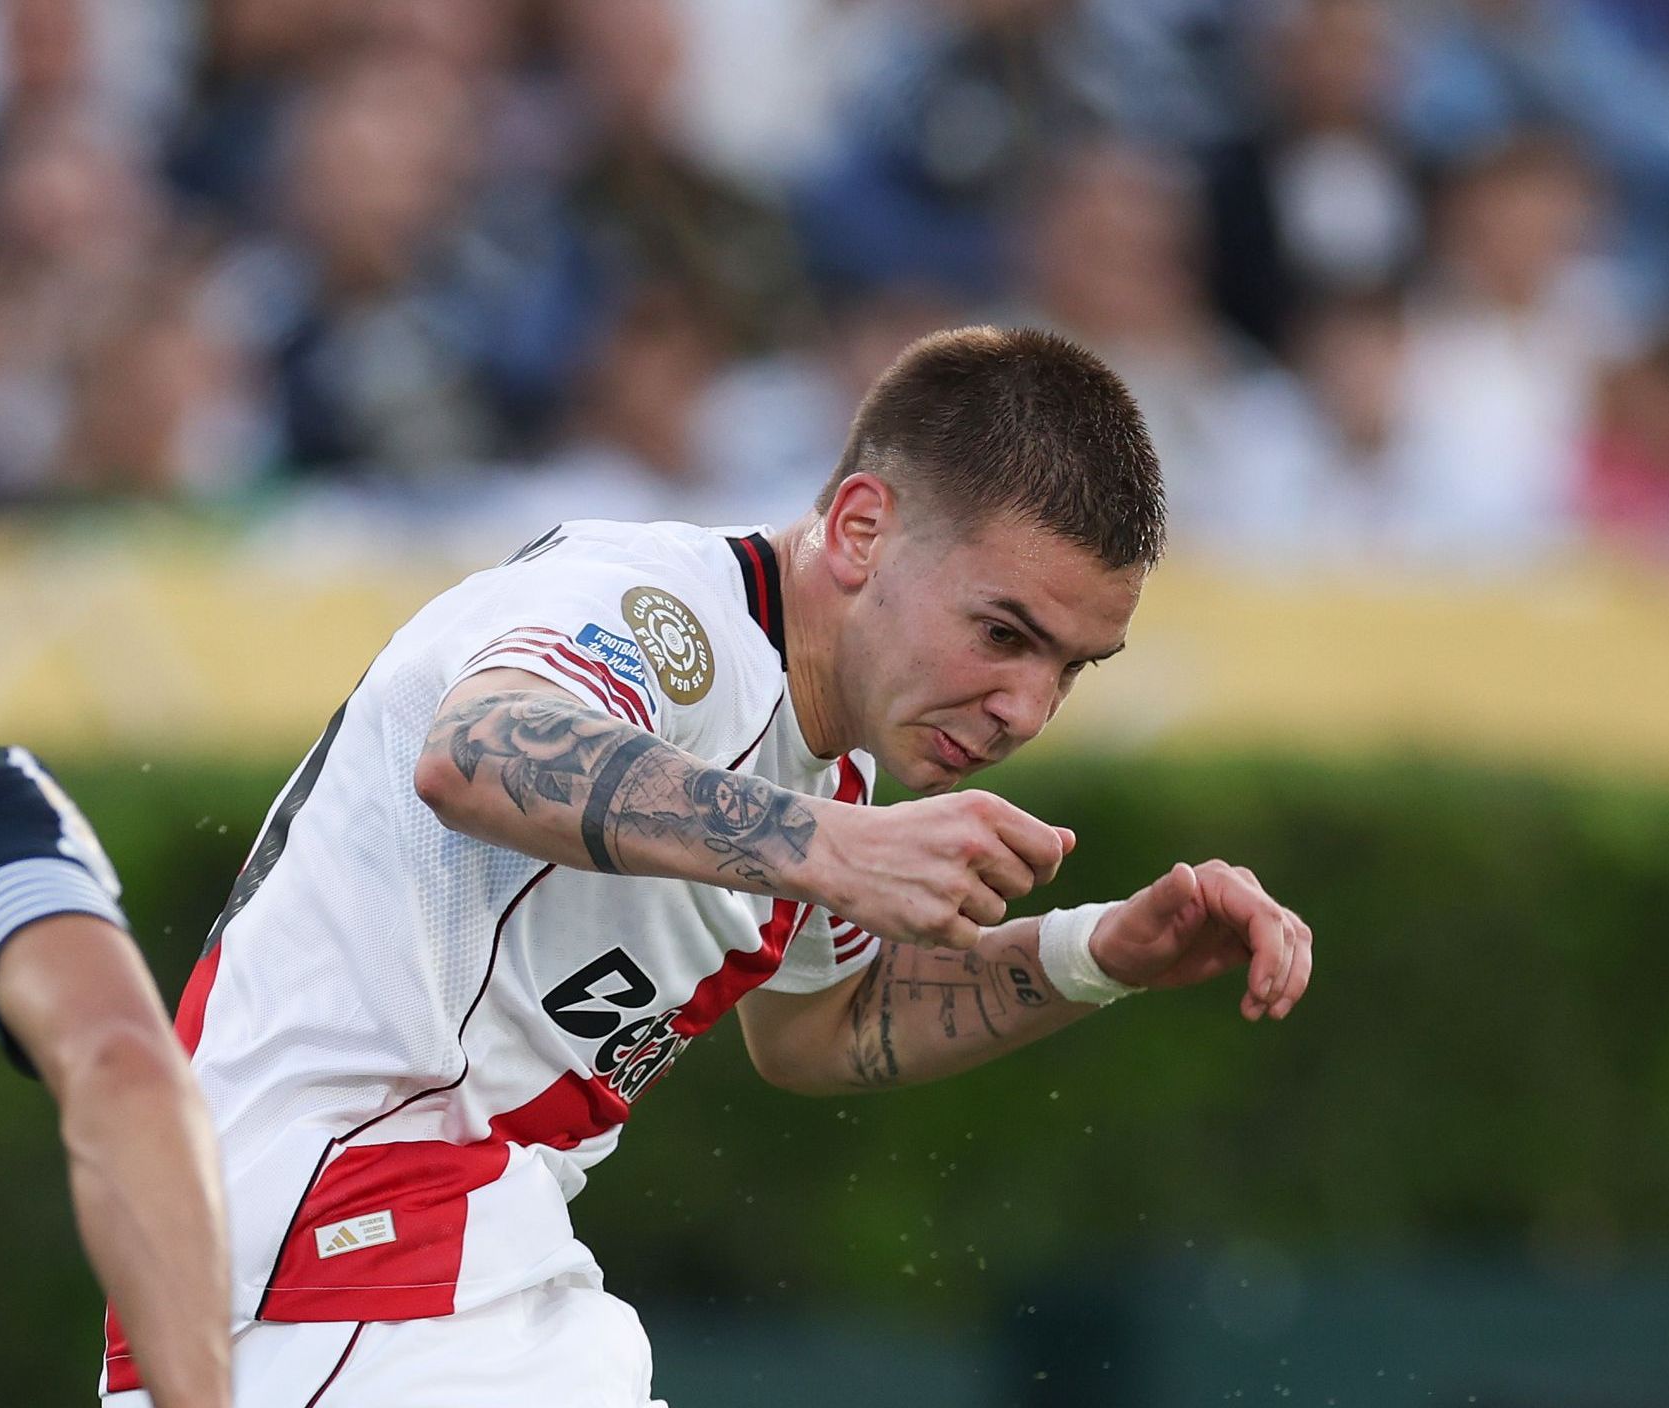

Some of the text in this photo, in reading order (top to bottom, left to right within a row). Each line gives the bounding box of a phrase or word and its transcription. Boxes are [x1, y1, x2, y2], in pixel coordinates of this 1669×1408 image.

[633, 595, 653, 620] CLUB
[652, 595, 696, 635] WORLD
[587, 641, 609, 660] the
[594, 631, 642, 661] FOOTBAL
[634, 626, 666, 673] FIFA
[695, 640, 707, 672] CUP
[670, 672, 691, 692] USA
[541, 946, 686, 1103] Beta
